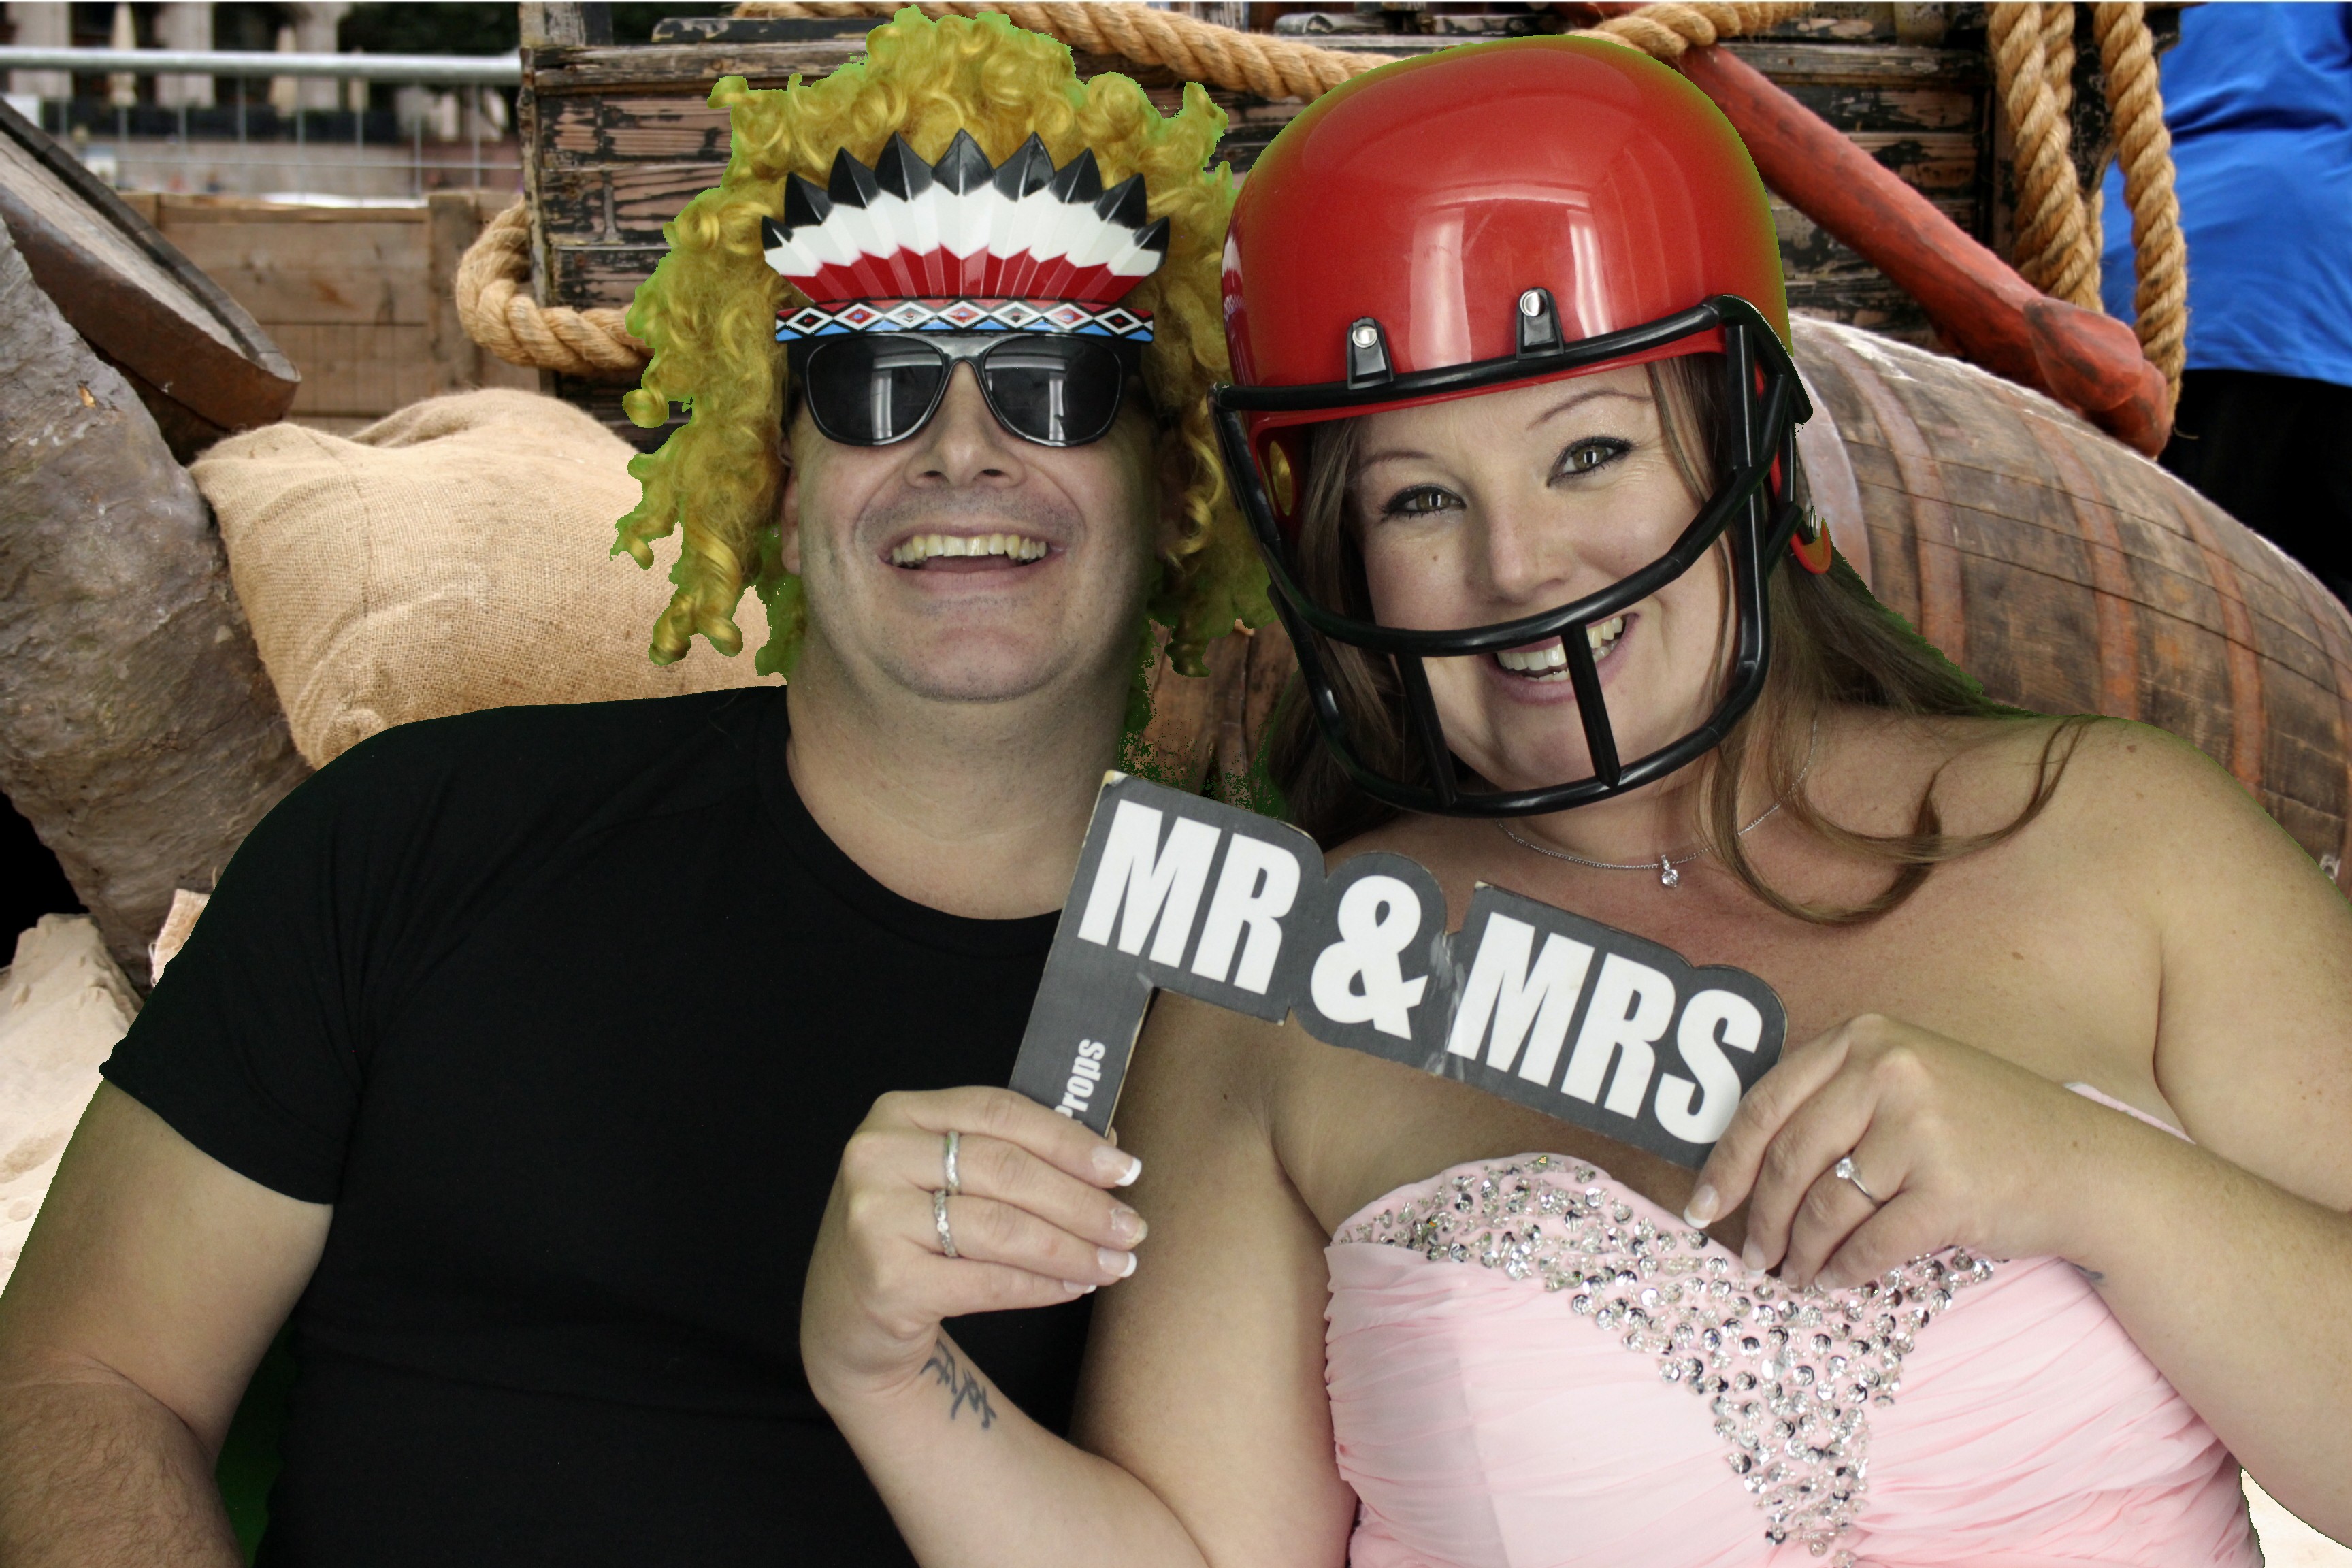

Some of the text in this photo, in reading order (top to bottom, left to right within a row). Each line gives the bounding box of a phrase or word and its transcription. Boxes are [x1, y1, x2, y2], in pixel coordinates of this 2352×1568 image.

[1078, 799, 1763, 1144] MR & MRS
